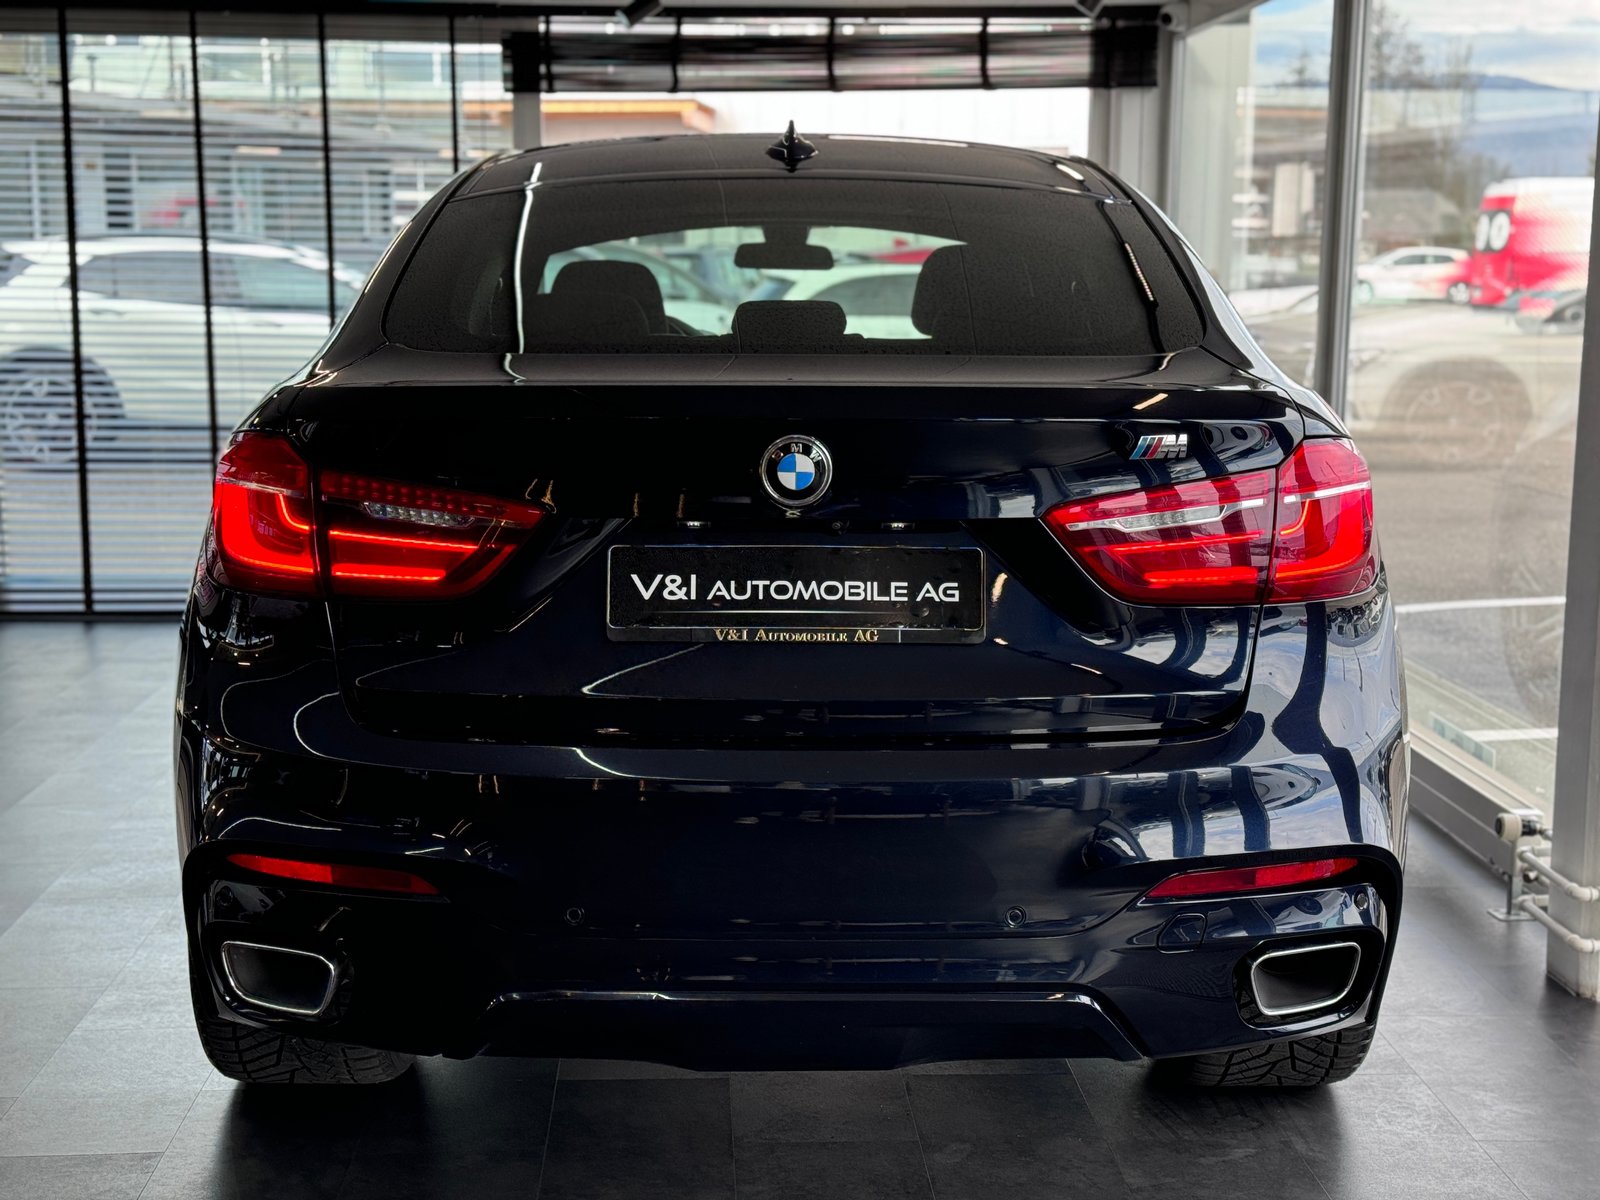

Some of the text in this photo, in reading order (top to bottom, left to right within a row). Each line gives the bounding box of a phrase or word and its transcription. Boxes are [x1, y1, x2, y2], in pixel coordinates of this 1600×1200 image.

[771, 443, 822, 463] BMW
[630, 573, 960, 602] V&I AUTOMOBILE AG
[713, 628, 749, 642] V&I
[853, 628, 880, 643] AG
